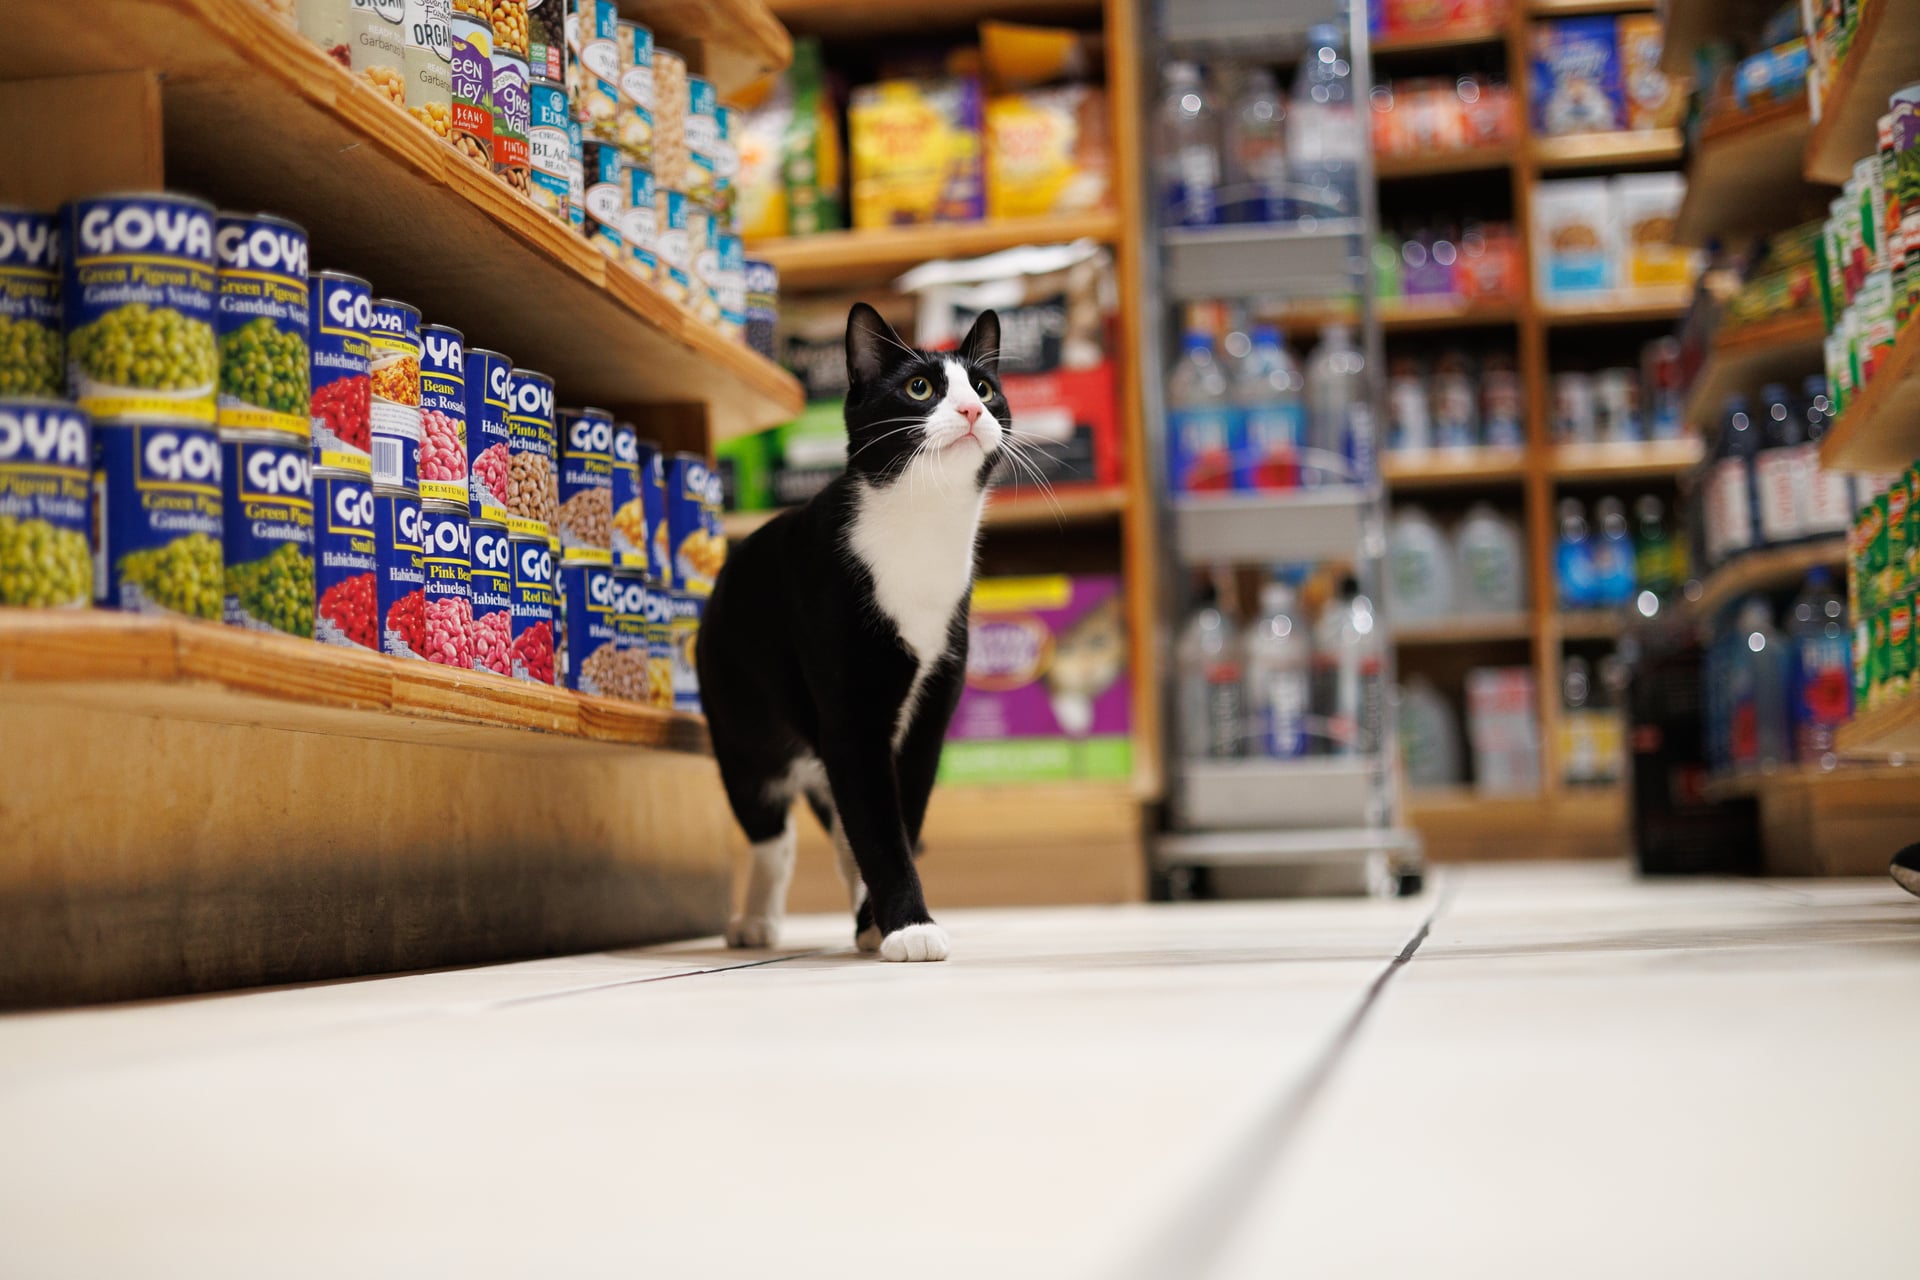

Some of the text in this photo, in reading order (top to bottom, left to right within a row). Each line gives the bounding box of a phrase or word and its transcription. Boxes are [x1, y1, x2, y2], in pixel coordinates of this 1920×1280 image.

[457, 108, 483, 124] BEANS
[532, 142, 568, 162] BLAC
[81, 207, 212, 258] GOYA
[217, 226, 309, 279] GOYA
[220, 295, 287, 318] Gandules
[328, 289, 371, 329] GO
[423, 378, 455, 396] Beans
[0, 412, 87, 464] OYA
[509, 422, 537, 438] Pinto
[569, 420, 613, 452] GO
[335, 487, 374, 526] GO
[475, 535, 509, 568] GO
[521, 549, 552, 581] GO
[430, 565, 456, 579] Pink
[523, 590, 540, 603] Red
